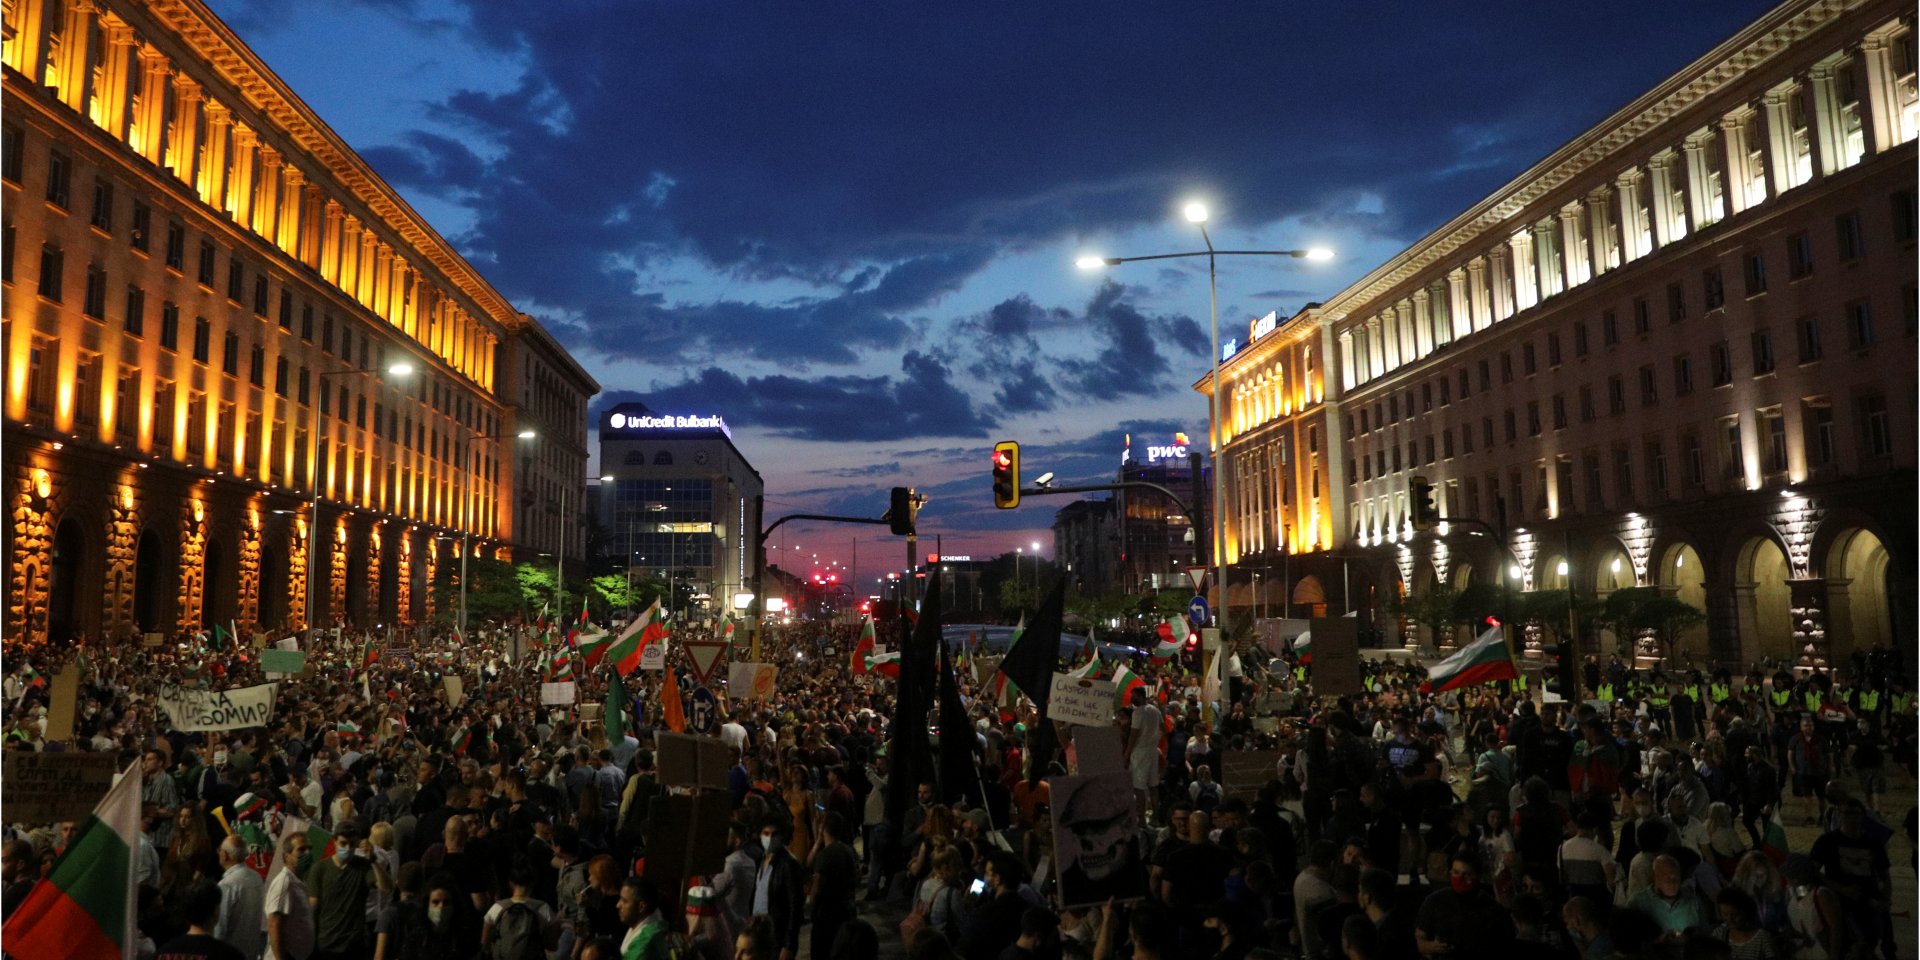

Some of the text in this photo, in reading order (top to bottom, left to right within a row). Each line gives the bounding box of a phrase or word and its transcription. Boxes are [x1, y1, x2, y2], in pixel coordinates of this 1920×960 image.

[628, 415, 720, 428] UniCredit Bulbank
[1147, 446, 1186, 462] pwc
